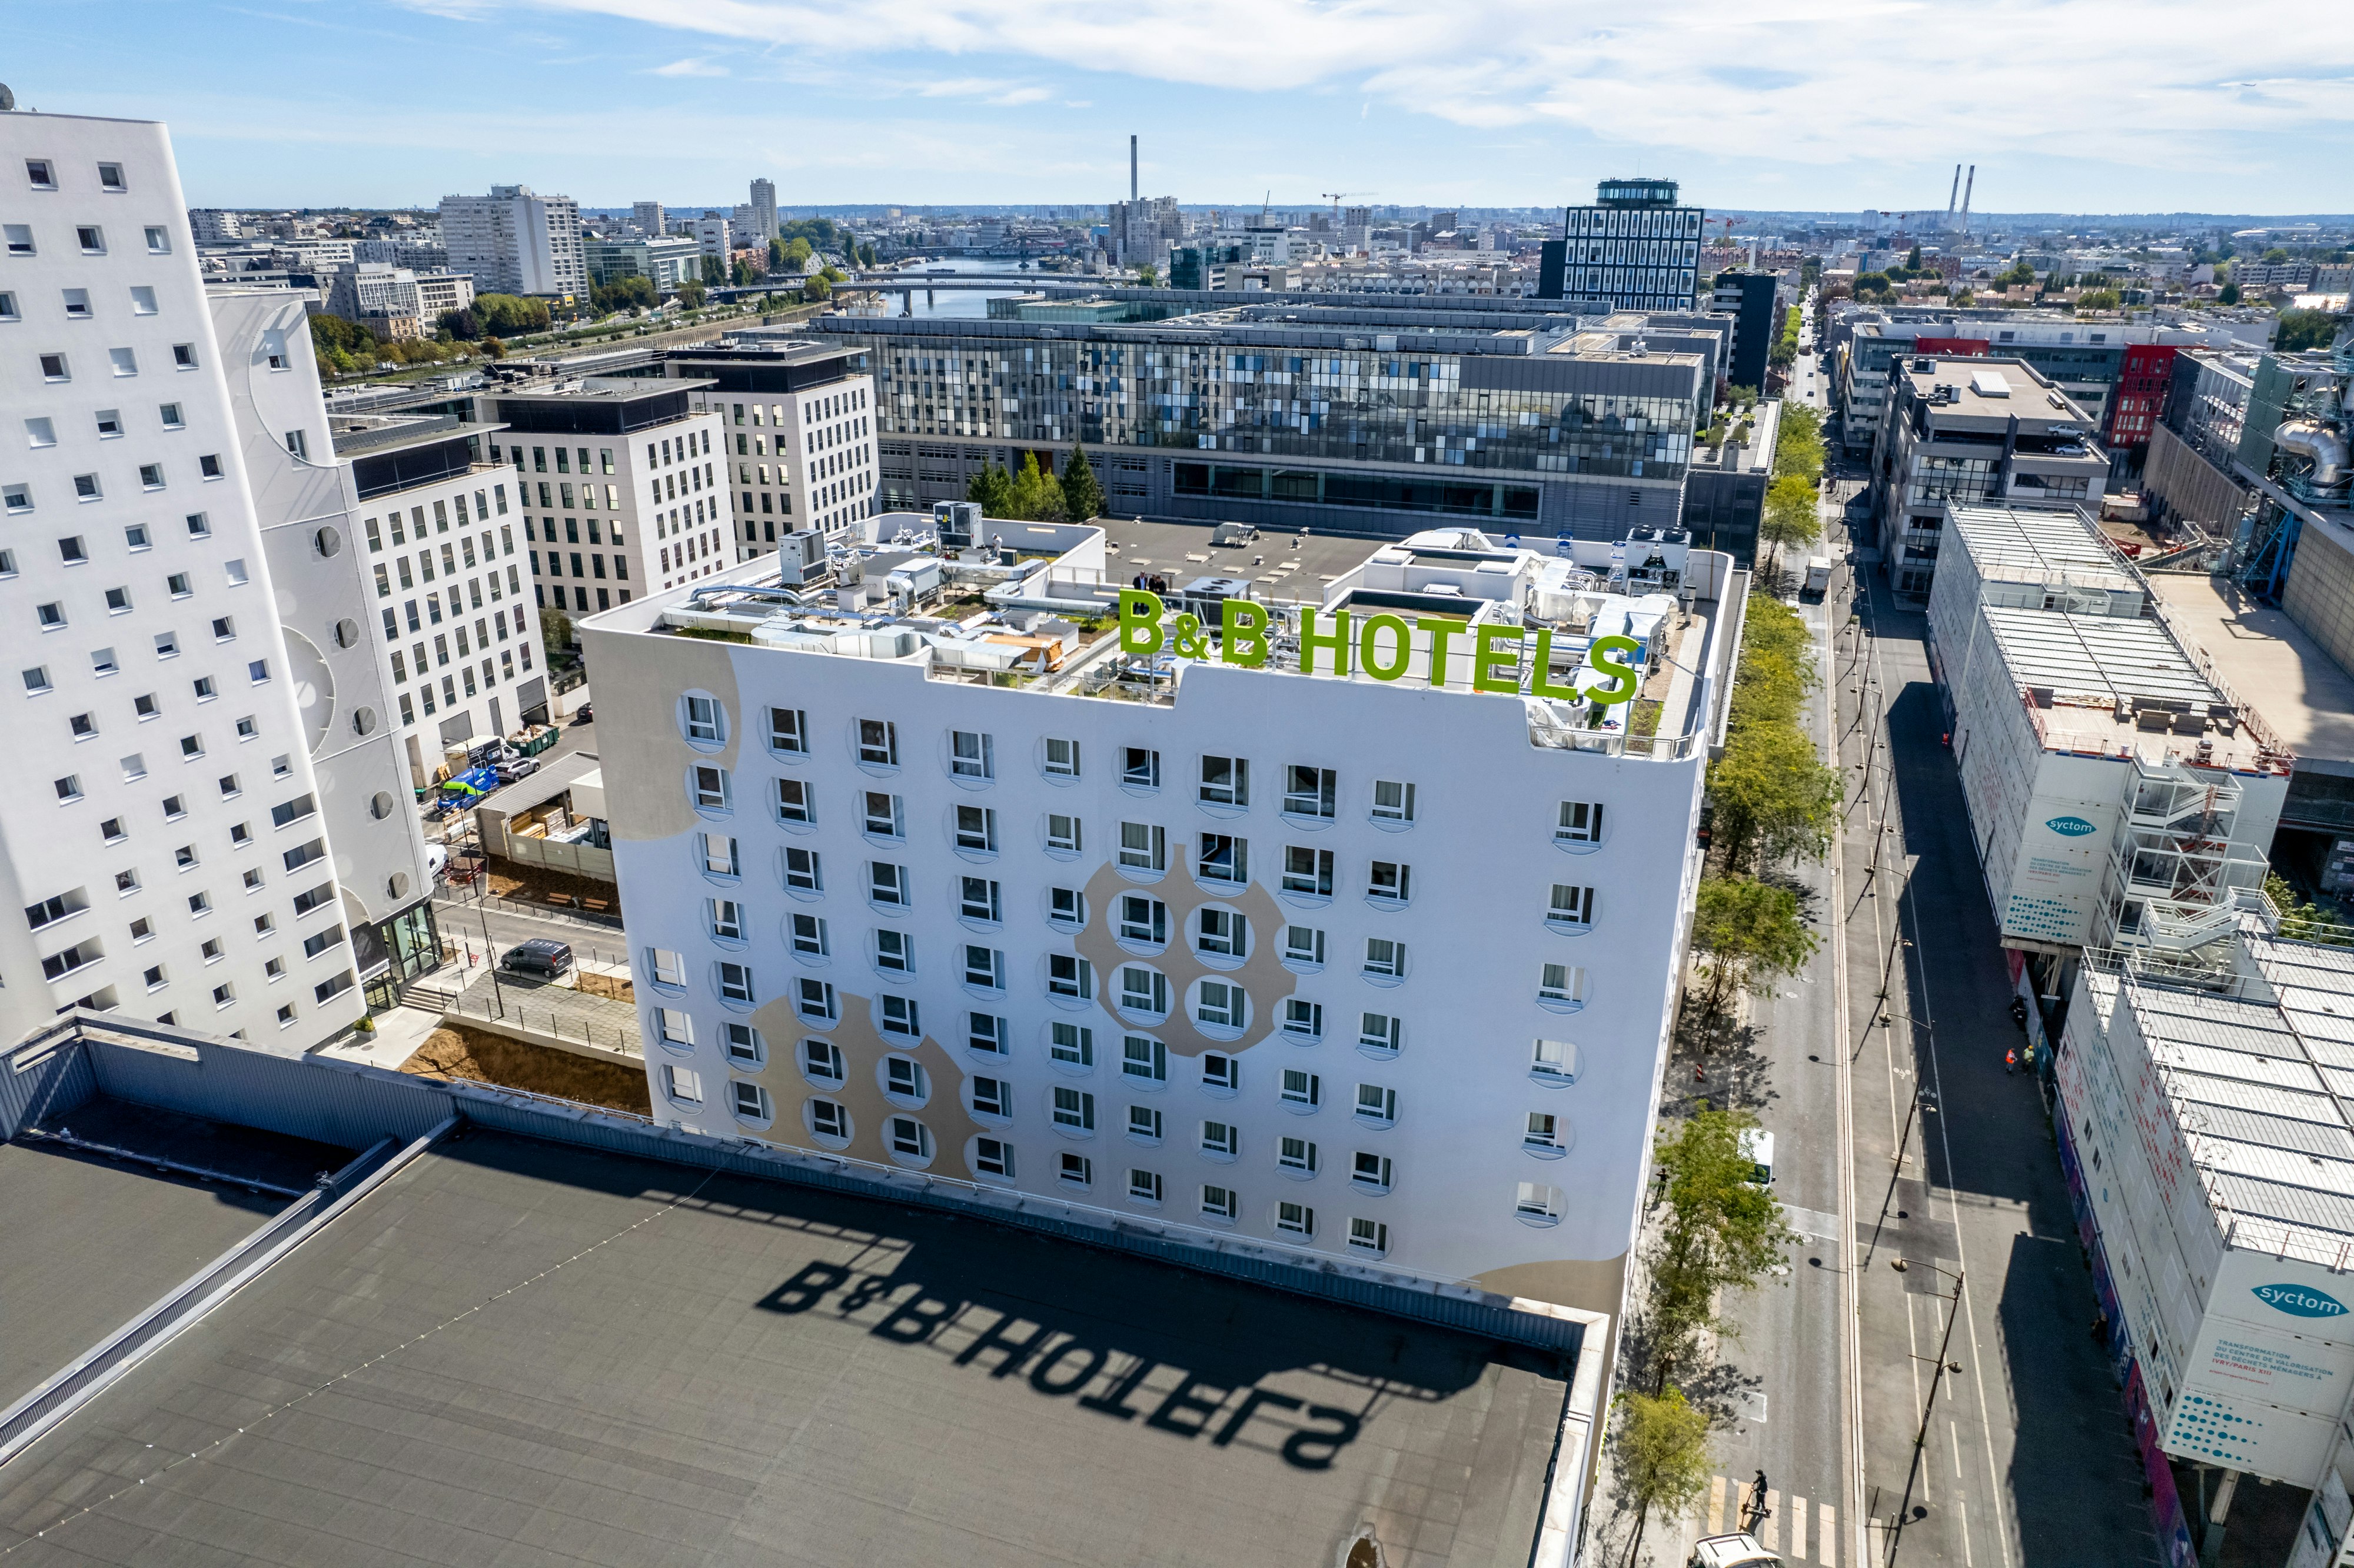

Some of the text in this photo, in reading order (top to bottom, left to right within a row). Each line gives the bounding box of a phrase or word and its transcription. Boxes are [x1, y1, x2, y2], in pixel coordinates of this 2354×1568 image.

[1119, 588, 1640, 705] B&B HOTELS
[2050, 820, 2092, 833] syctom
[2259, 1287, 2341, 1314] syctom
[2218, 1339, 2290, 1359] TRANSFORMATION
[2212, 1358, 2256, 1372] IVRY/PARIS
[2229, 1349, 2260, 1360] CENTRE
[2276, 1359, 2333, 1376] VALORISATION
[2232, 1355, 2268, 1368] DÉCHETS
[2270, 1365, 2314, 1379] MÉNAGERS
